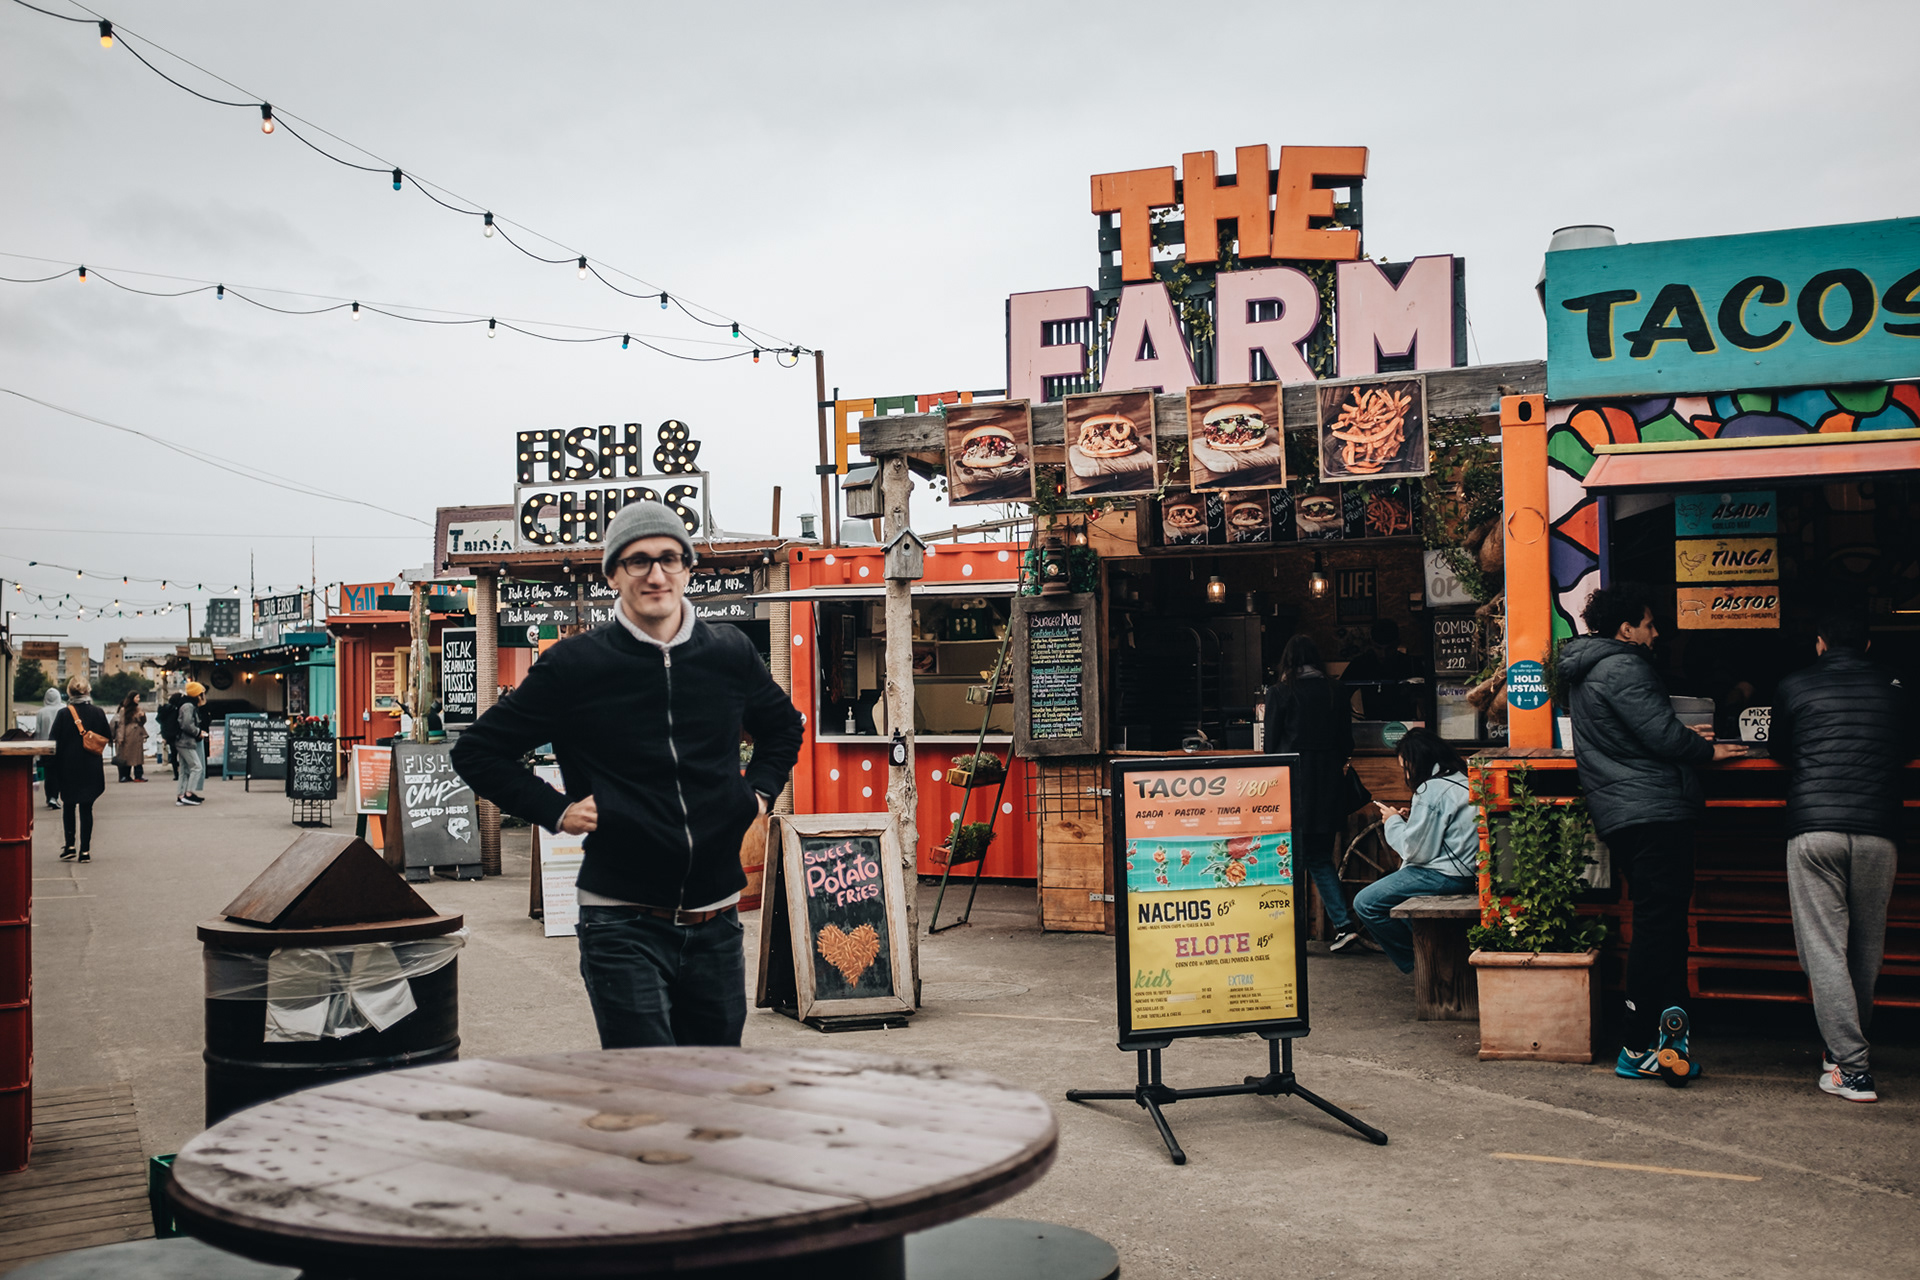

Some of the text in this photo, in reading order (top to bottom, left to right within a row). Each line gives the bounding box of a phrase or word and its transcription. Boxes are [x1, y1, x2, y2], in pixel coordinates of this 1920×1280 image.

[1091, 144, 1369, 281] THE
[1006, 254, 1455, 401] FARM
[517, 420, 701, 483] FISH &
[1711, 502, 1771, 521] ASADA
[1711, 548, 1775, 567] TINGA
[508, 585, 522, 600] Fish
[531, 584, 551, 600] Chips
[1340, 571, 1373, 598] LIFE
[1431, 576, 1472, 598] OP
[263, 597, 295, 616] BIG EASY
[344, 585, 389, 611] Yall
[1711, 595, 1778, 611] PASTOR
[508, 609, 522, 622] Fish
[524, 610, 549, 625] Burger
[1030, 612, 1082, 628] BURGER MENU
[1434, 620, 1475, 635] COMBO
[446, 641, 472, 659] STEAK
[444, 660, 477, 673] BEARNAISE
[444, 673, 474, 692] MUSSELS
[1514, 675, 1541, 683] HOLD
[1507, 684, 1549, 693] AFSTAND
[448, 693, 477, 704] SANDWICH
[1741, 718, 1771, 727] TACO
[293, 740, 333, 752] REPUBLIQUE
[293, 750, 327, 767] STEAK
[402, 754, 454, 774] FISH
[405, 776, 461, 808] Chips
[1133, 776, 1227, 799] TACOS
[408, 805, 469, 818] SERVED HERE
[1135, 804, 1280, 819] ASADA PASTOR TINGA VEGGIE
[804, 841, 853, 865] SWEET
[807, 854, 879, 898] Potato
[1138, 900, 1211, 924] NACHOS
[1259, 899, 1290, 910] PASTOR
[1174, 932, 1250, 957] ELOTE
[1175, 960, 1188, 968] CORN
[1231, 955, 1249, 963] POWDER
[1255, 953, 1270, 961] CHEESE
[1134, 968, 1173, 989] kids
[1228, 974, 1254, 986] EXTRAS
